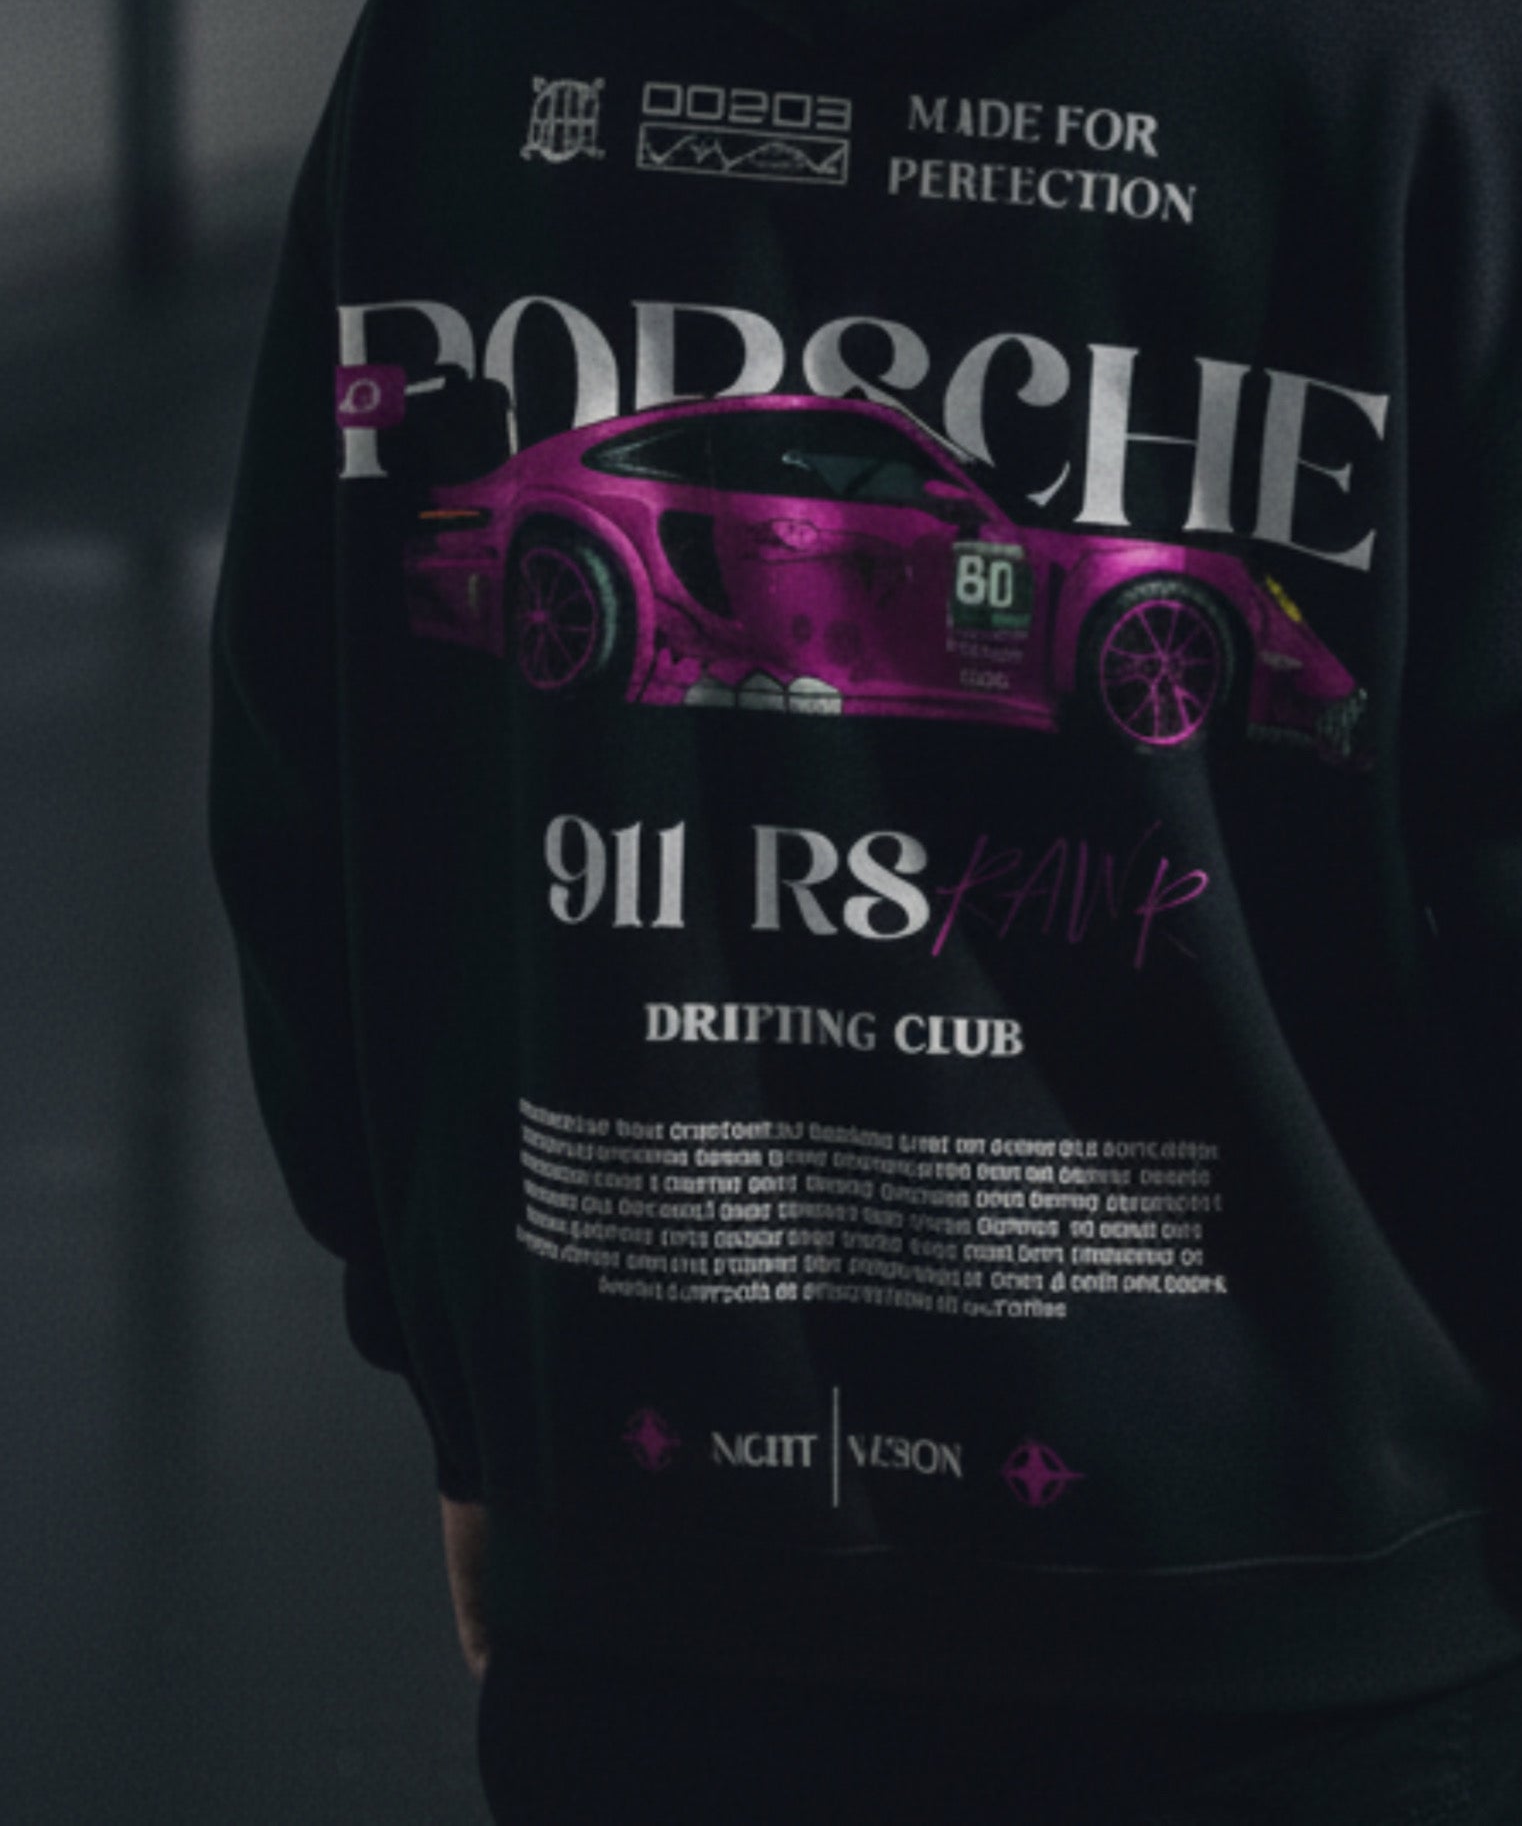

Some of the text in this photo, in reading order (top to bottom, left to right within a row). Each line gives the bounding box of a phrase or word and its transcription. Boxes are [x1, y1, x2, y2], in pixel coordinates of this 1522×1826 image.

[907, 94, 1159, 158] MADE FOR
[543, 813, 686, 929] 911
[750, 823, 931, 941] RS
[894, 1014, 1024, 1058] CLUB
